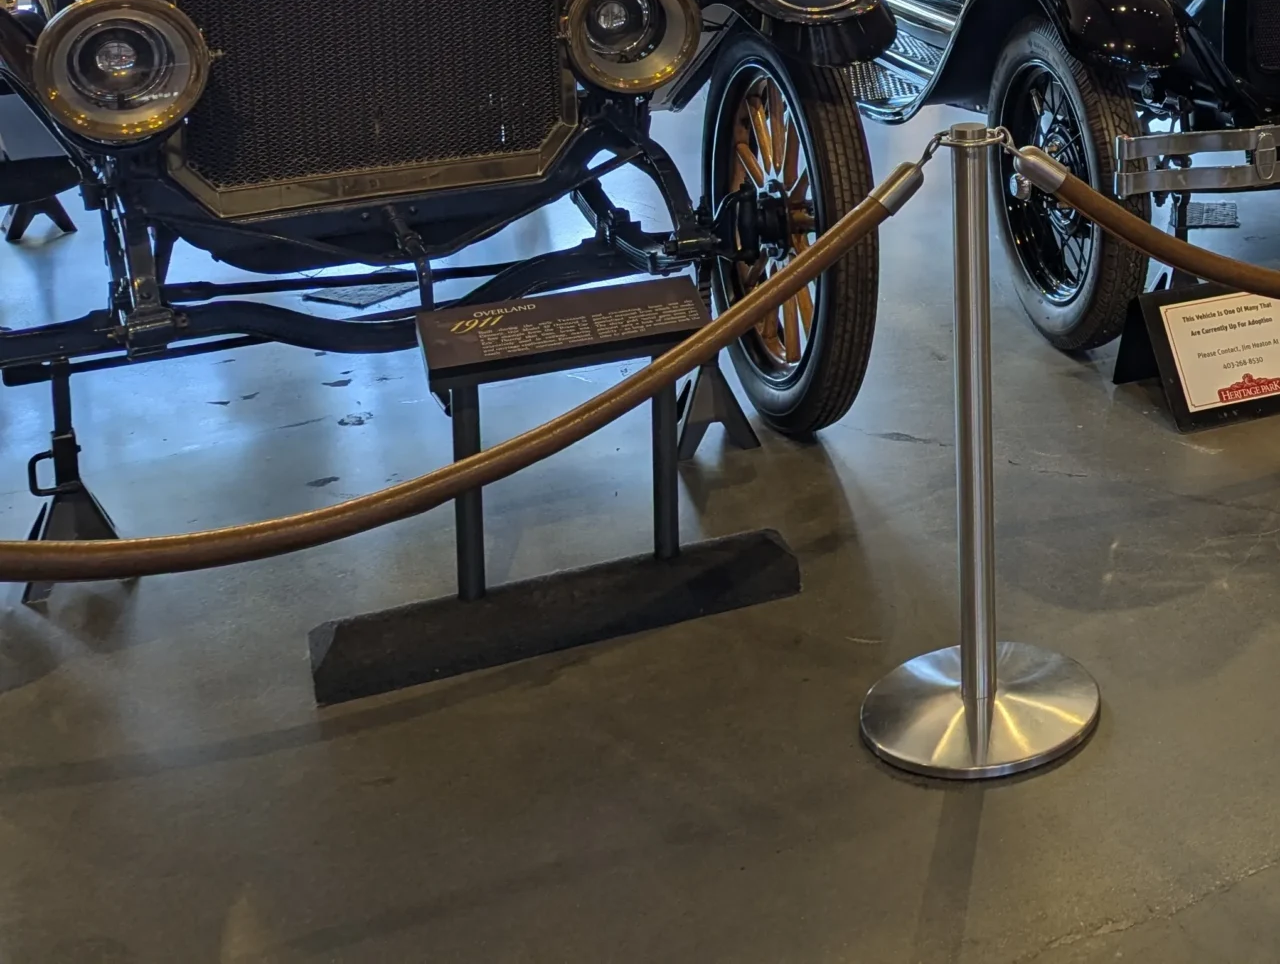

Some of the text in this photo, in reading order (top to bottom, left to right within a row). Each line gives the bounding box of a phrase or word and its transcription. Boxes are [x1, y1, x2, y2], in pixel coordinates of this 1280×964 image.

[473, 304, 536, 318] OVERLAND
[1196, 312, 1216, 320] Vehicle
[450, 315, 504, 334] 1911
[1202, 324, 1228, 334] Currently
[1248, 317, 1273, 326] Adoption
[1198, 349, 1216, 358] Please
[1217, 346, 1241, 356] Contact,
[1242, 343, 1251, 351] Jim
[1252, 340, 1272, 349] Heaton
[1223, 357, 1264, 369] 403-268-8530
[1221, 386, 1261, 401] HERITAGE
